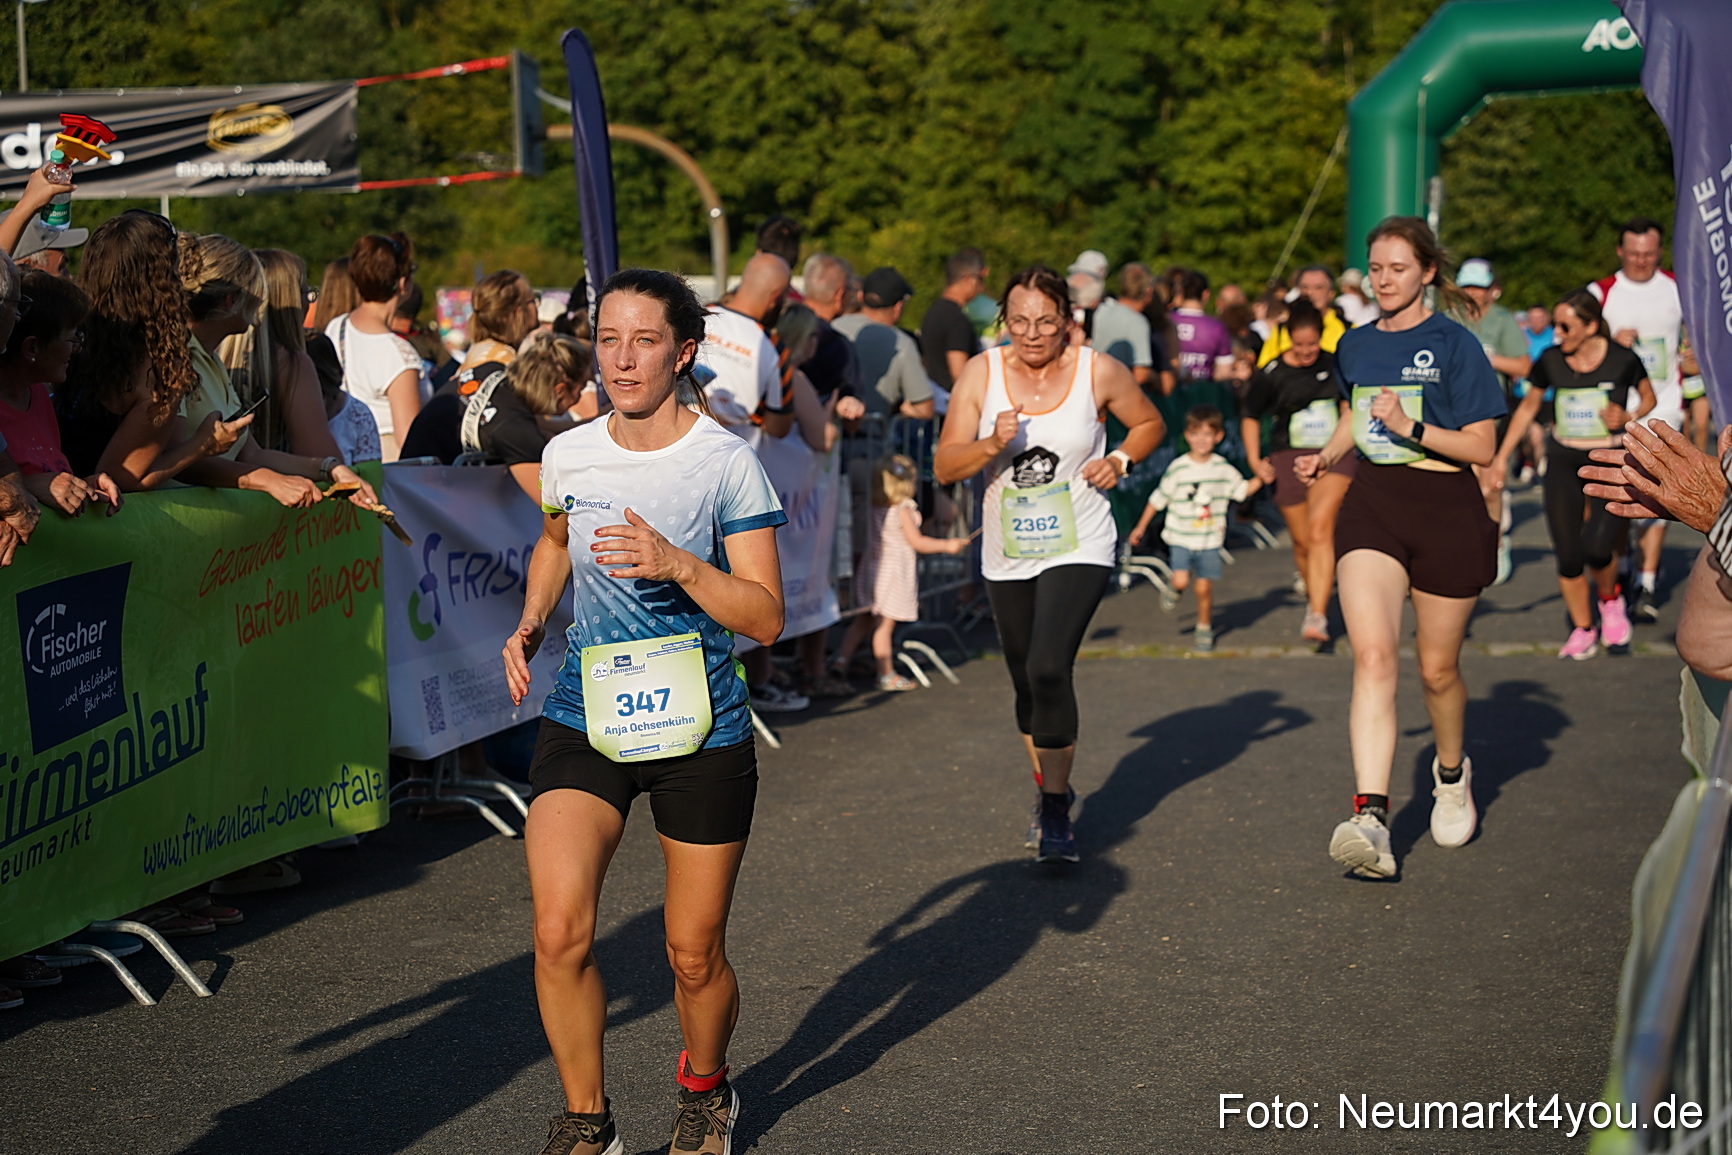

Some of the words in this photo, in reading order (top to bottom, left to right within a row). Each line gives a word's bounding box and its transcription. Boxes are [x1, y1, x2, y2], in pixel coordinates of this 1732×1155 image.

[1582, 16, 1643, 52] AO
[576, 499, 610, 510] Bionorica
[1012, 516, 1059, 531] 2362
[199, 513, 288, 598] Gesunde
[236, 578, 301, 647] laufen
[42, 620, 107, 663] Fischer
[50, 647, 101, 678] AUTOMOBILE
[610, 663, 646, 676] Firmenlauf
[616, 687, 671, 717] 347
[604, 724, 628, 737] Anja
[630, 716, 696, 733] Ochsenkühn
